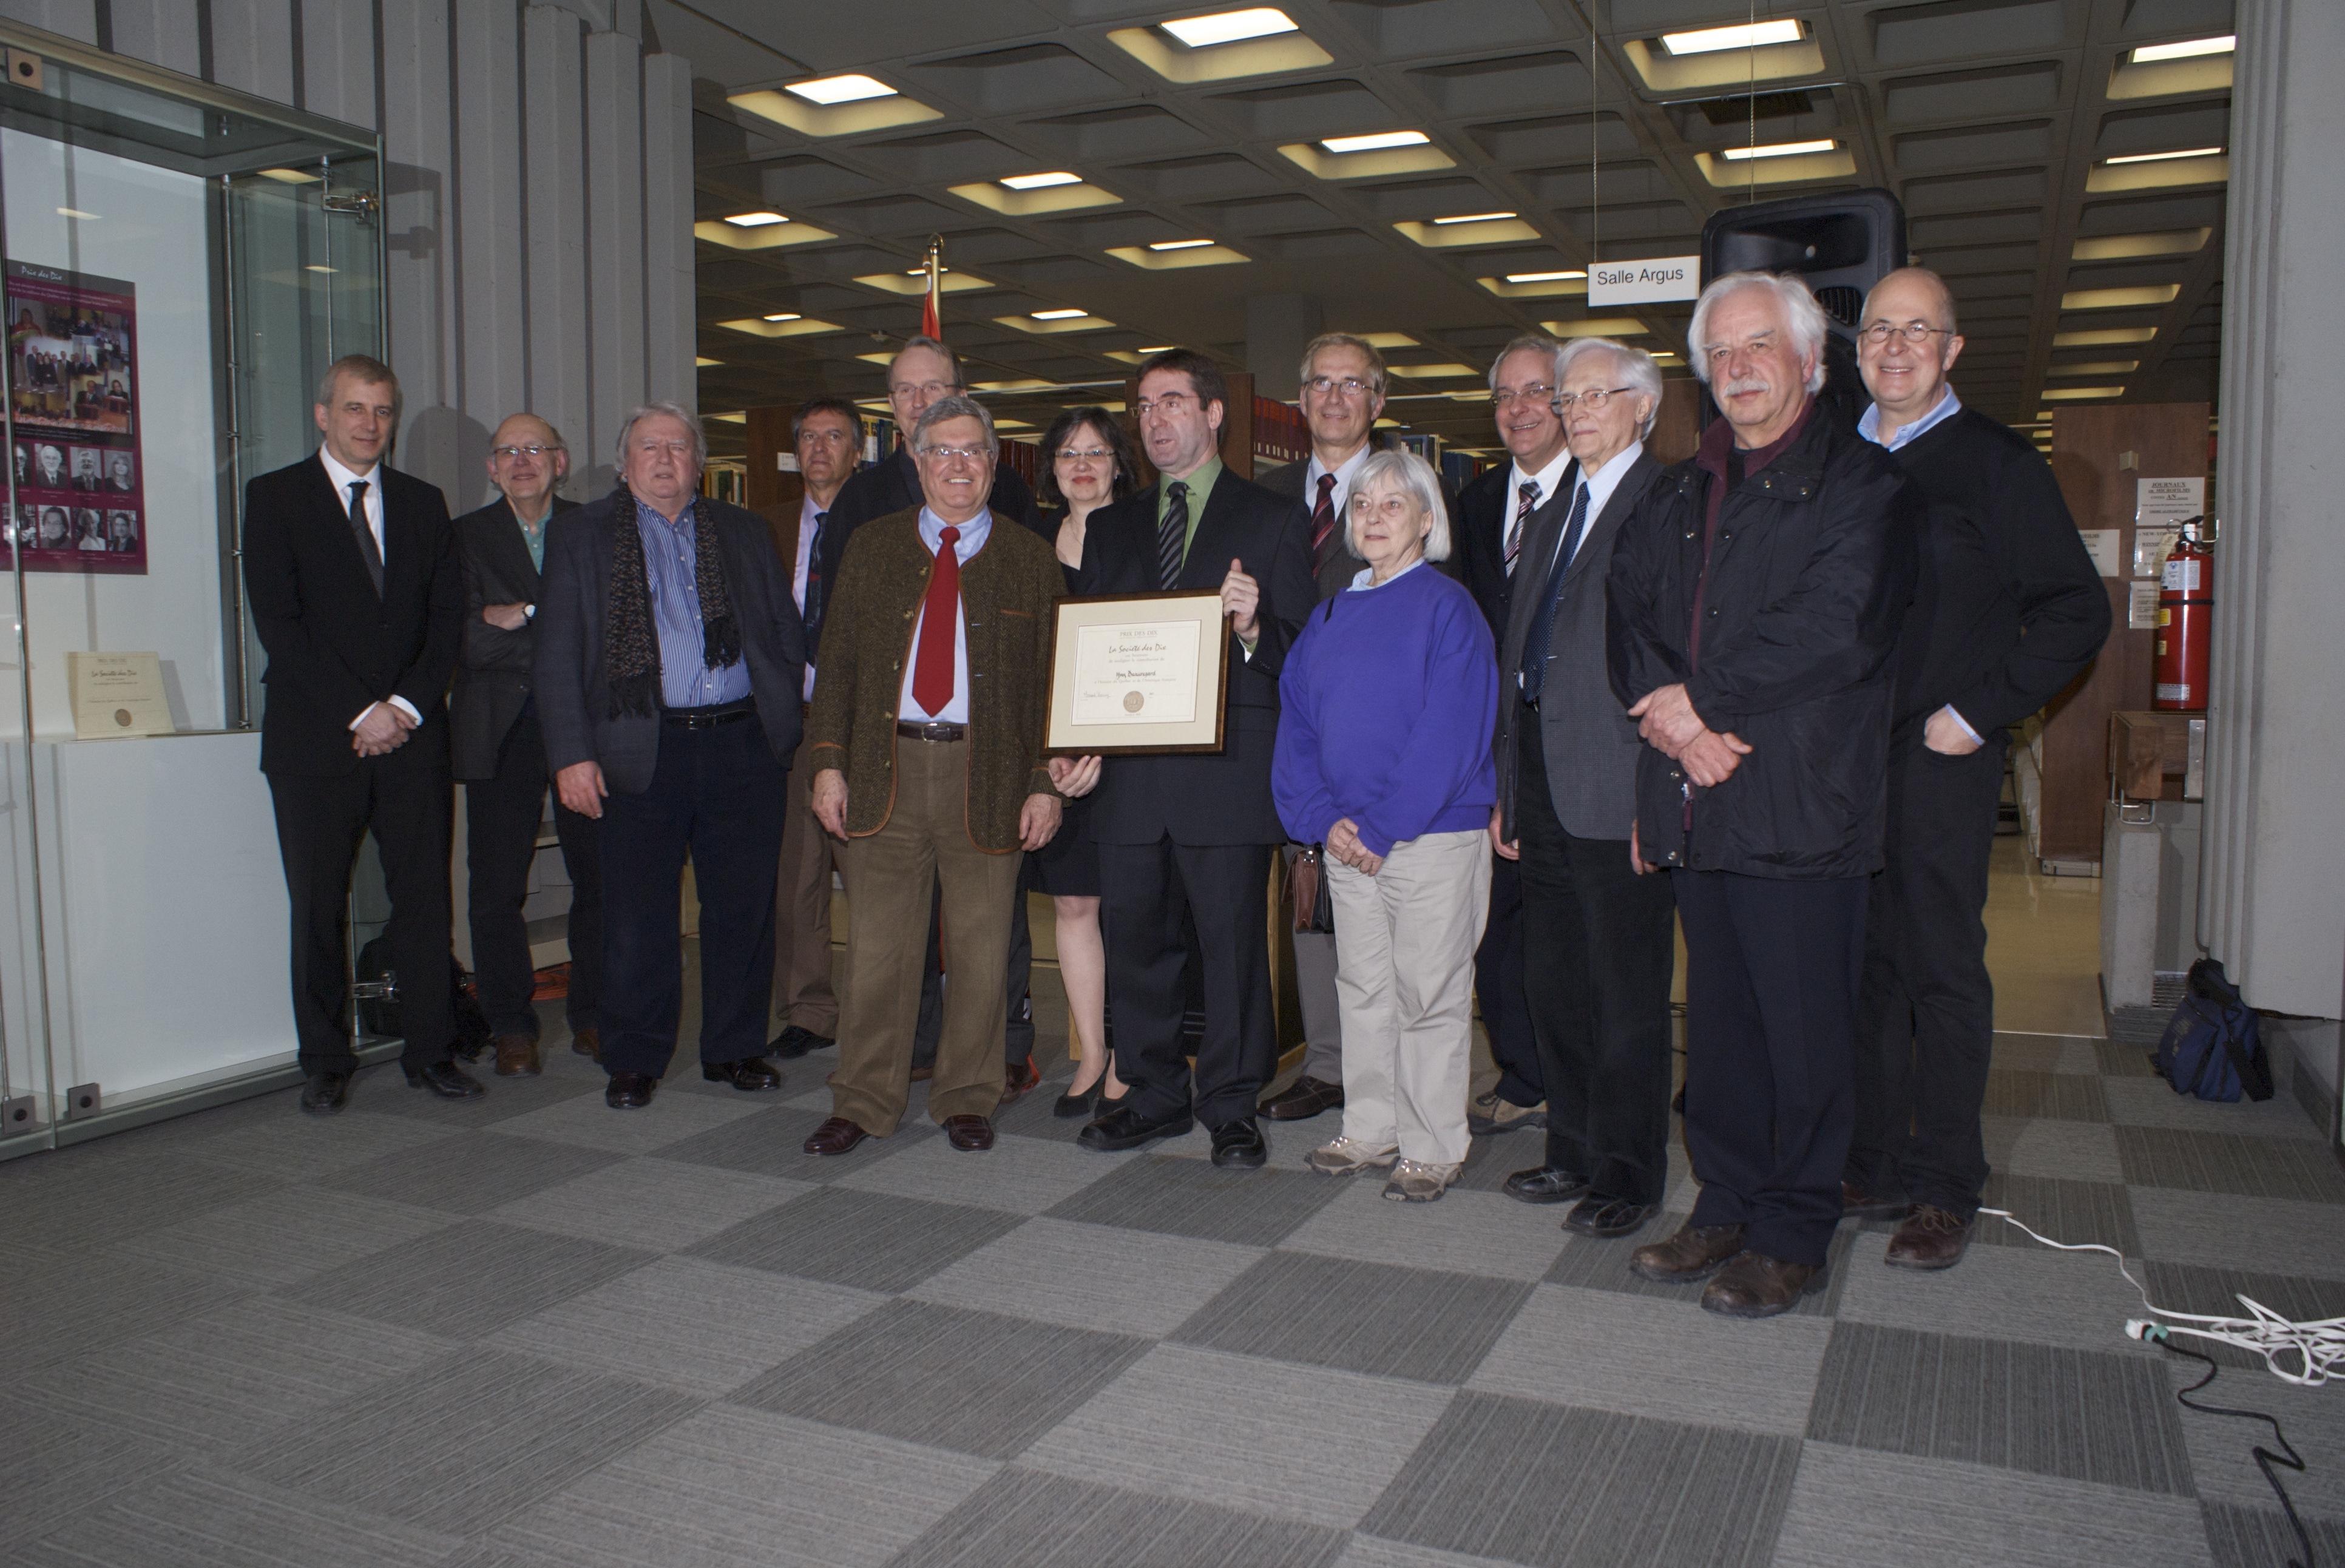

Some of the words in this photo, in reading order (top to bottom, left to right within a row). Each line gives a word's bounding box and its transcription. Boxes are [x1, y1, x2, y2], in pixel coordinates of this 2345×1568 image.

[1597, 270, 1634, 285] Salle
[1639, 268, 1683, 285] Argus
[1155, 643, 1167, 652] Dix
